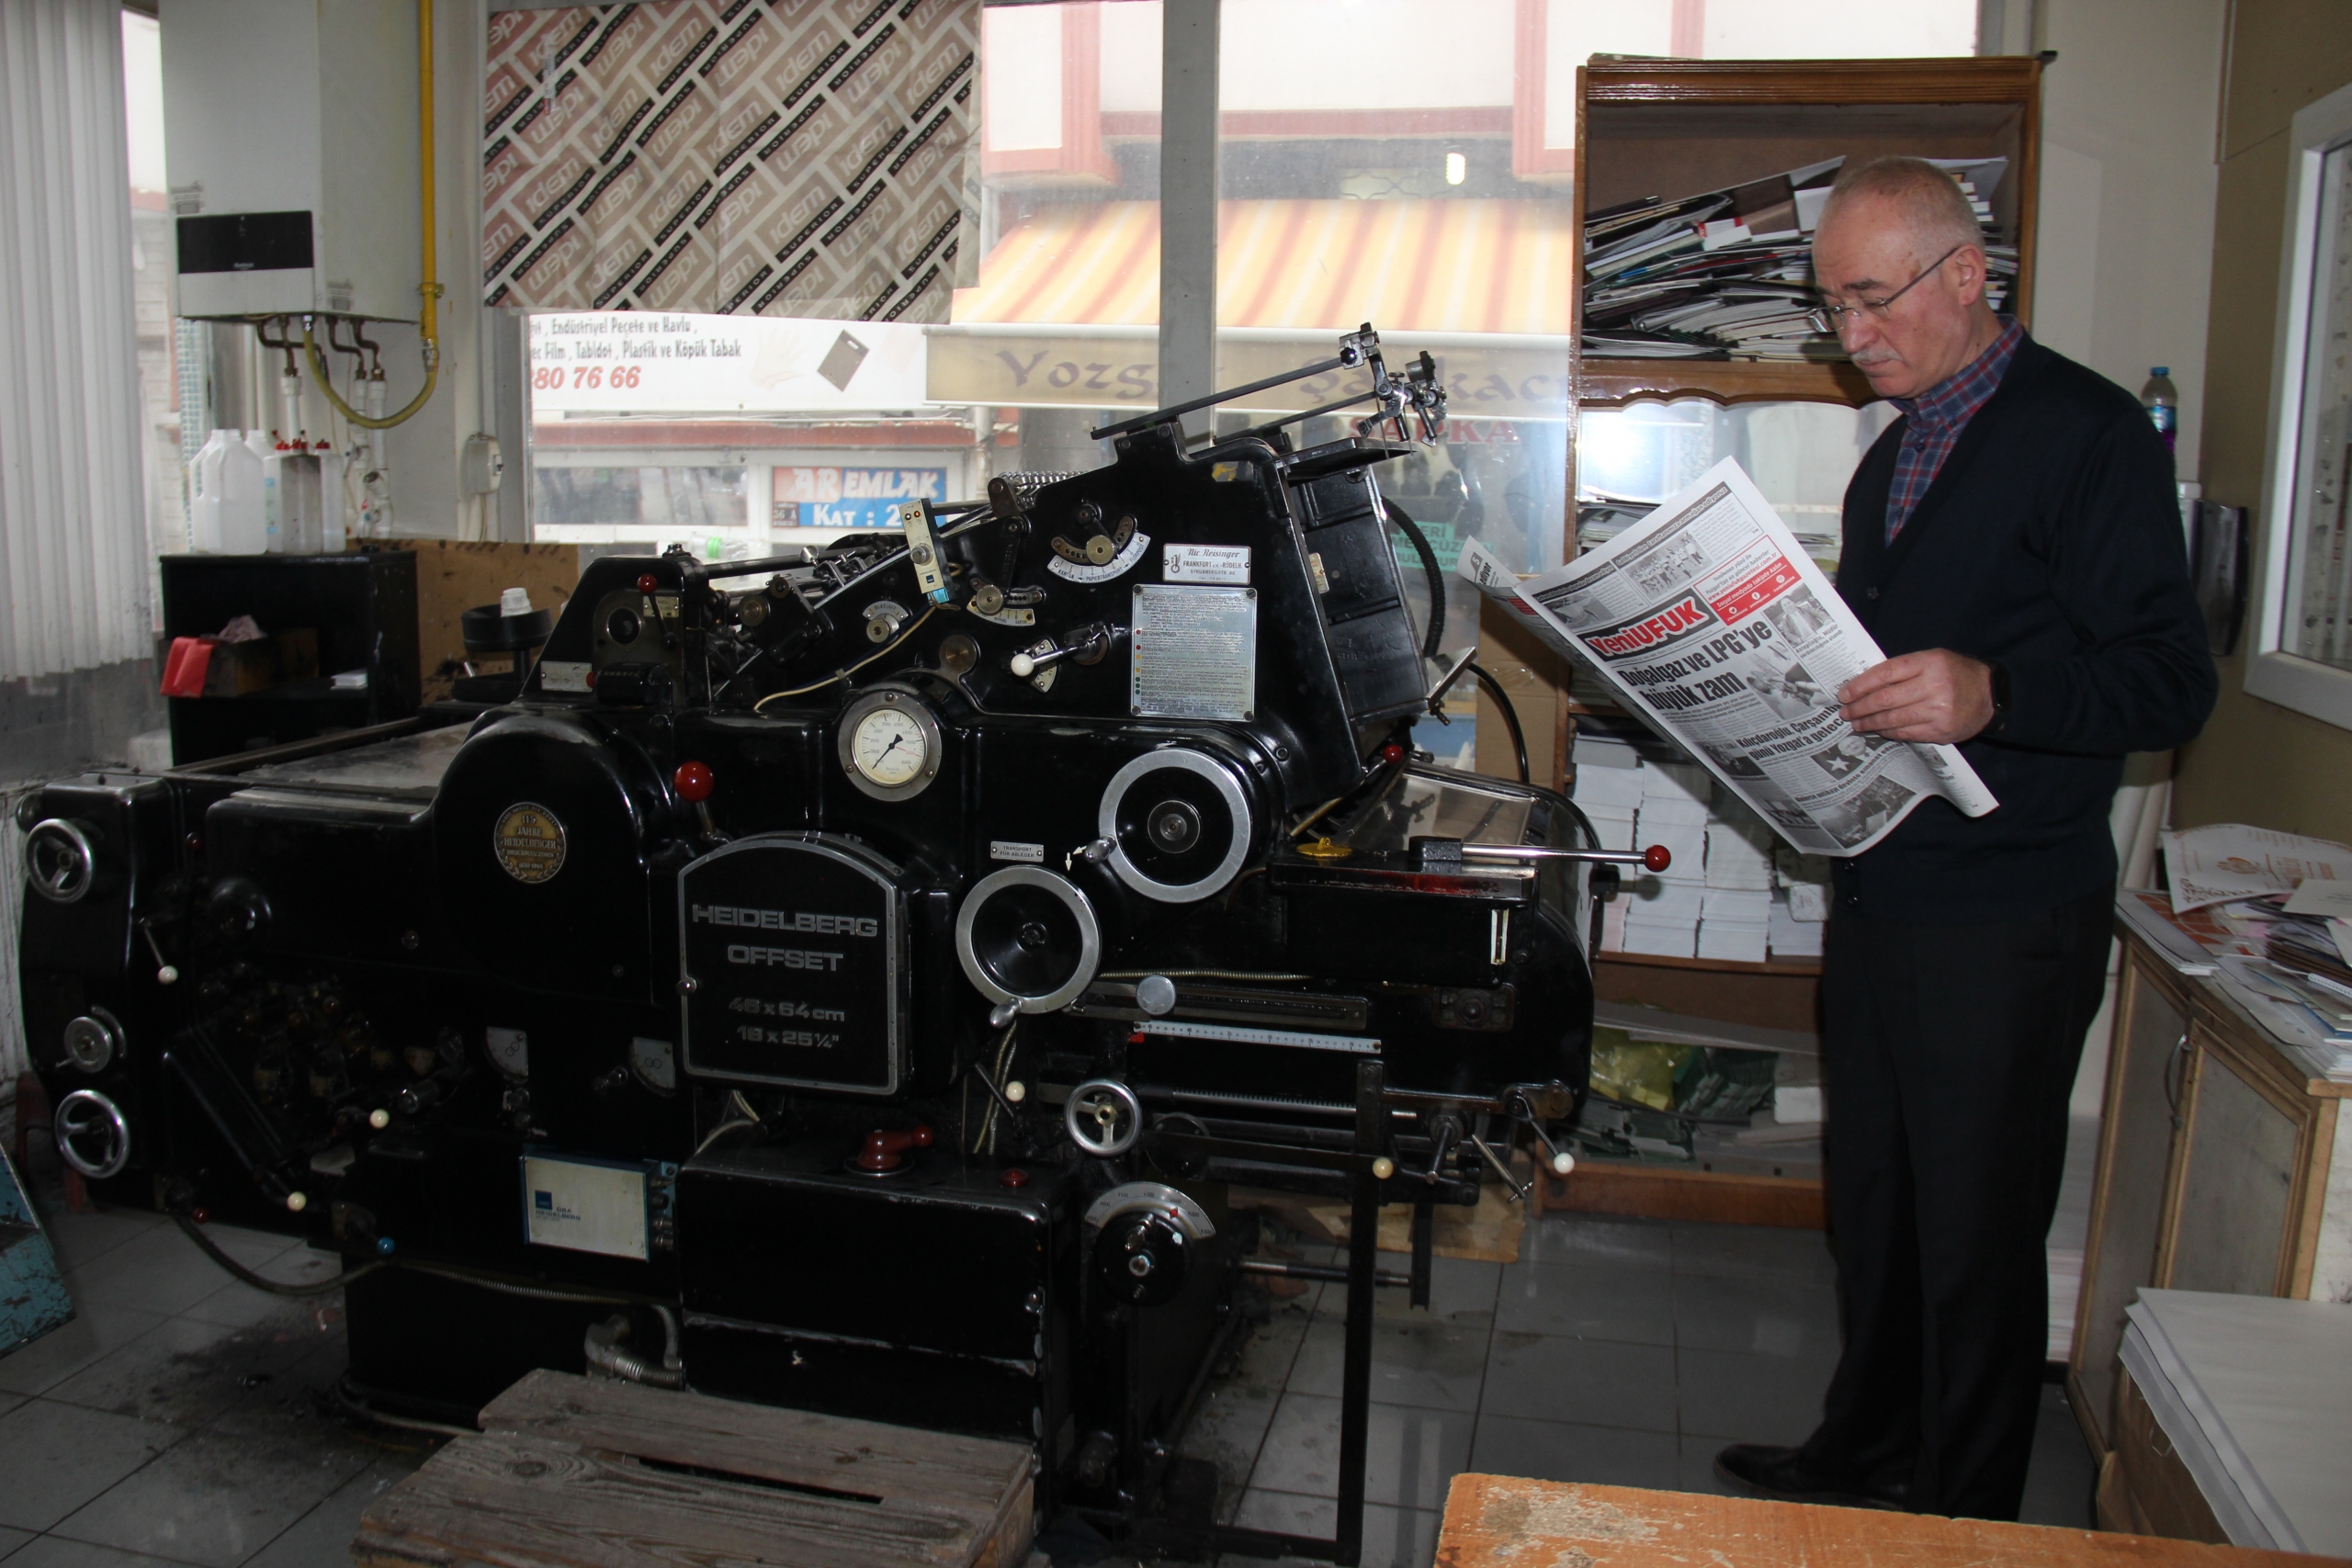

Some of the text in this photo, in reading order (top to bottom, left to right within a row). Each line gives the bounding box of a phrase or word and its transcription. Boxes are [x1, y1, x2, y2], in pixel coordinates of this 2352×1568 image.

[650, 17, 703, 77] idem
[662, 33, 714, 89] SUPERIOR
[704, 15, 757, 71] SUPERIOR
[776, 29, 831, 91] idem
[834, 29, 890, 85] SUPERIOR
[789, 47, 844, 103] SUPERIOR
[907, 42, 960, 106] idem
[918, 60, 971, 116] SUPERIOR
[485, 90, 527, 134] PERIOR
[605, 104, 650, 159] SUPERIOR
[641, 87, 691, 141] SUPERIOR
[763, 101, 820, 154] SUPERIOR
[718, 118, 775, 171] SUPERIOR
[854, 132, 903, 187] SUPERIOR
[893, 113, 946, 170] SUPERIOR
[526, 157, 582, 214] idem
[539, 173, 591, 223] SUPERIOR
[582, 155, 632, 209] SUPERIOR
[700, 170, 749, 223] SUPERIOR
[660, 186, 708, 241] SUPERIOR
[770, 186, 826, 245] idem
[782, 202, 839, 256] SUPERIOR
[828, 186, 880, 241] SUPERIOR
[896, 199, 948, 262] idem
[517, 224, 569, 275] SUPERIOR
[639, 238, 687, 291] SUPERIOR
[909, 217, 959, 273] SUPERIOR
[596, 254, 648, 307] SUPERIOR
[759, 254, 811, 308] SUPERIOR
[545, 343, 565, 359] Film
[576, 341, 613, 359] Tabldot
[623, 340, 657, 358] Plastik
[661, 346, 672, 358] ve
[675, 339, 707, 359] Köpük
[710, 339, 741, 357] Tabak
[552, 317, 607, 336] Endüstriyel
[612, 318, 644, 337] Peçete
[648, 321, 659, 333] ve
[663, 316, 691, 333] Havlu
[530, 366, 641, 389] 80 76 66
[995, 349, 1159, 400] Yozg
[787, 468, 938, 499] AR EMLAK
[1058, 570, 1075, 580] KARTON
[1472, 556, 1480, 565] 5
[1717, 562, 1782, 607] Sosyal medyada takipte kalın
[1750, 550, 1770, 567] haberler
[1587, 597, 1708, 656] YeniUFUK
[1617, 659, 1691, 687] Doğalgaz
[1680, 650, 1711, 672] ve
[1702, 620, 1772, 664] LPG'ye
[1638, 684, 1705, 711] büyük
[1693, 671, 1748, 702] zam
[1736, 723, 1794, 749] Kılıçdaroğlu,
[1790, 703, 1843, 735] Çarşamba
[1748, 745, 1773, 761] günü
[1770, 734, 1813, 756] Yozgat'a
[1811, 714, 1847, 743] gelec
[503, 837, 557, 850] HEIDELBERGER
[517, 827, 542, 837] JAHRE
[692, 904, 878, 937] HEIDELBERG
[727, 944, 844, 972] OFFSET
[737, 1025, 763, 1043] 18
[536, 1210, 581, 1221] HEIDELBERG
